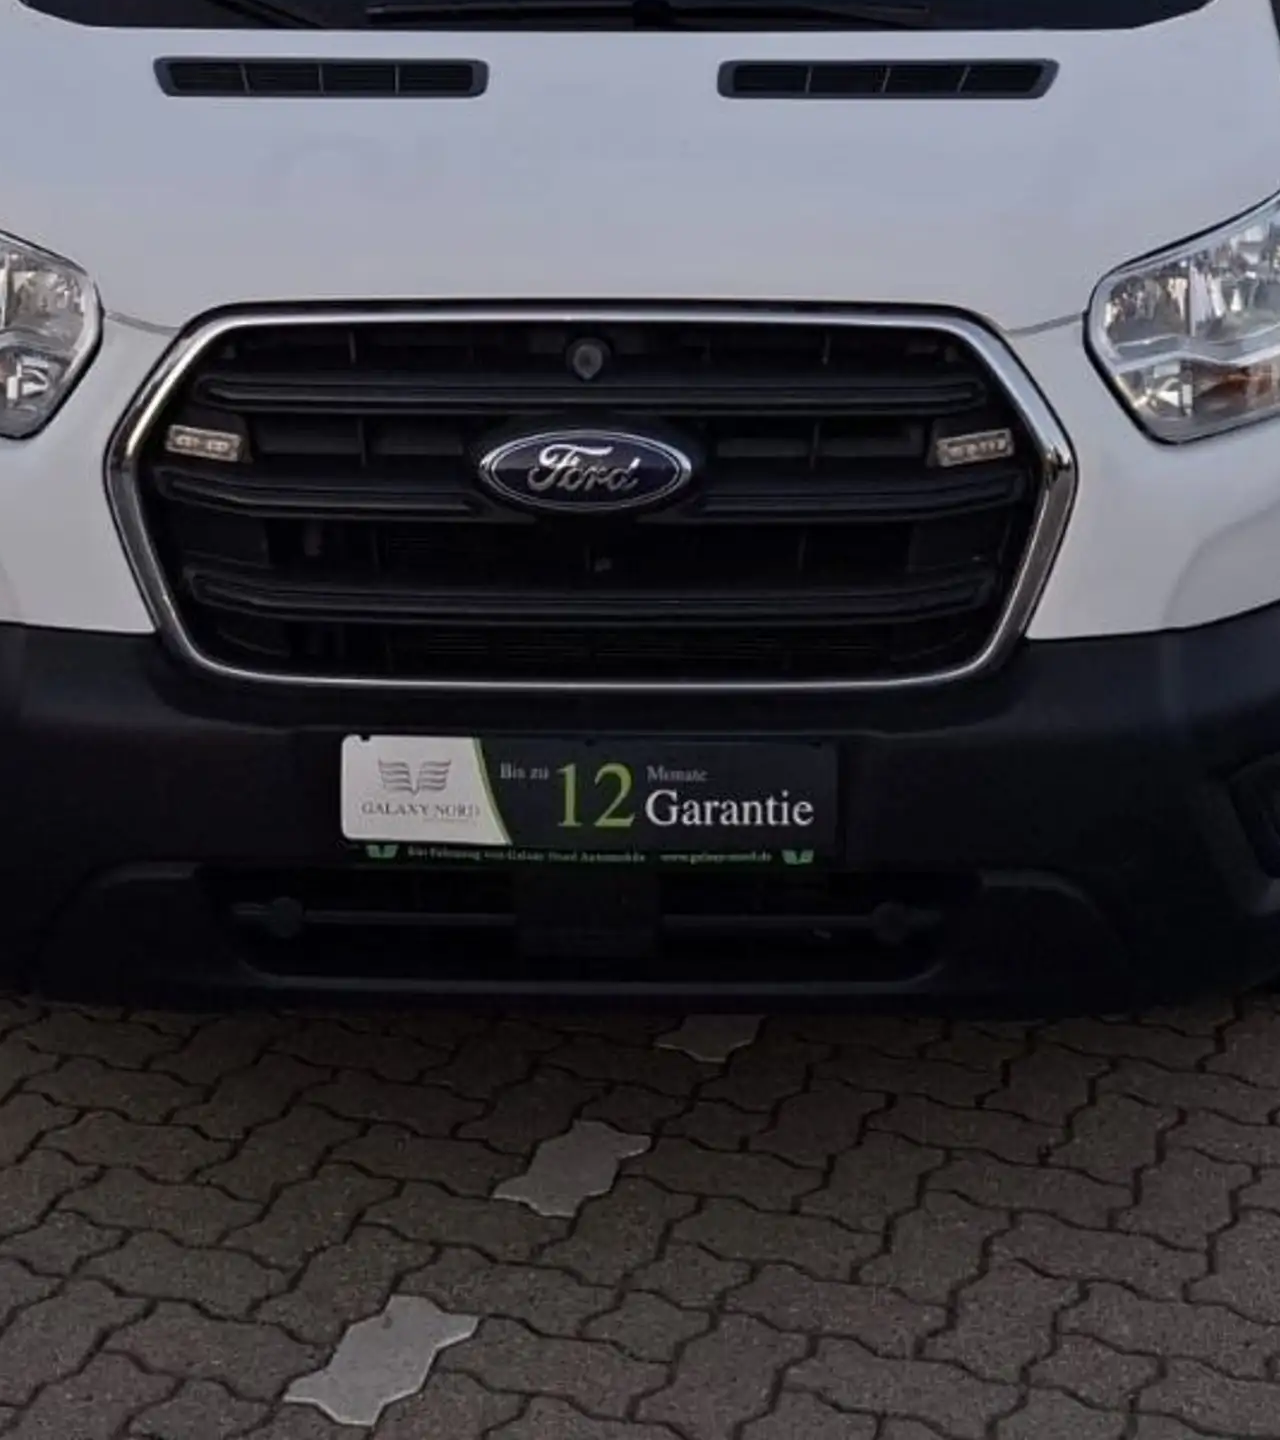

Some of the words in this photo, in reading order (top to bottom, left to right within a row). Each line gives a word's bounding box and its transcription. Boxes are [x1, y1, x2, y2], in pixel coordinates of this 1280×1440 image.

[526, 442, 642, 492] Ford
[645, 764, 708, 782] Monate
[361, 801, 430, 817] GALAXY
[433, 802, 480, 819] NORD
[557, 762, 635, 828] 12
[645, 788, 815, 827] Garantie
